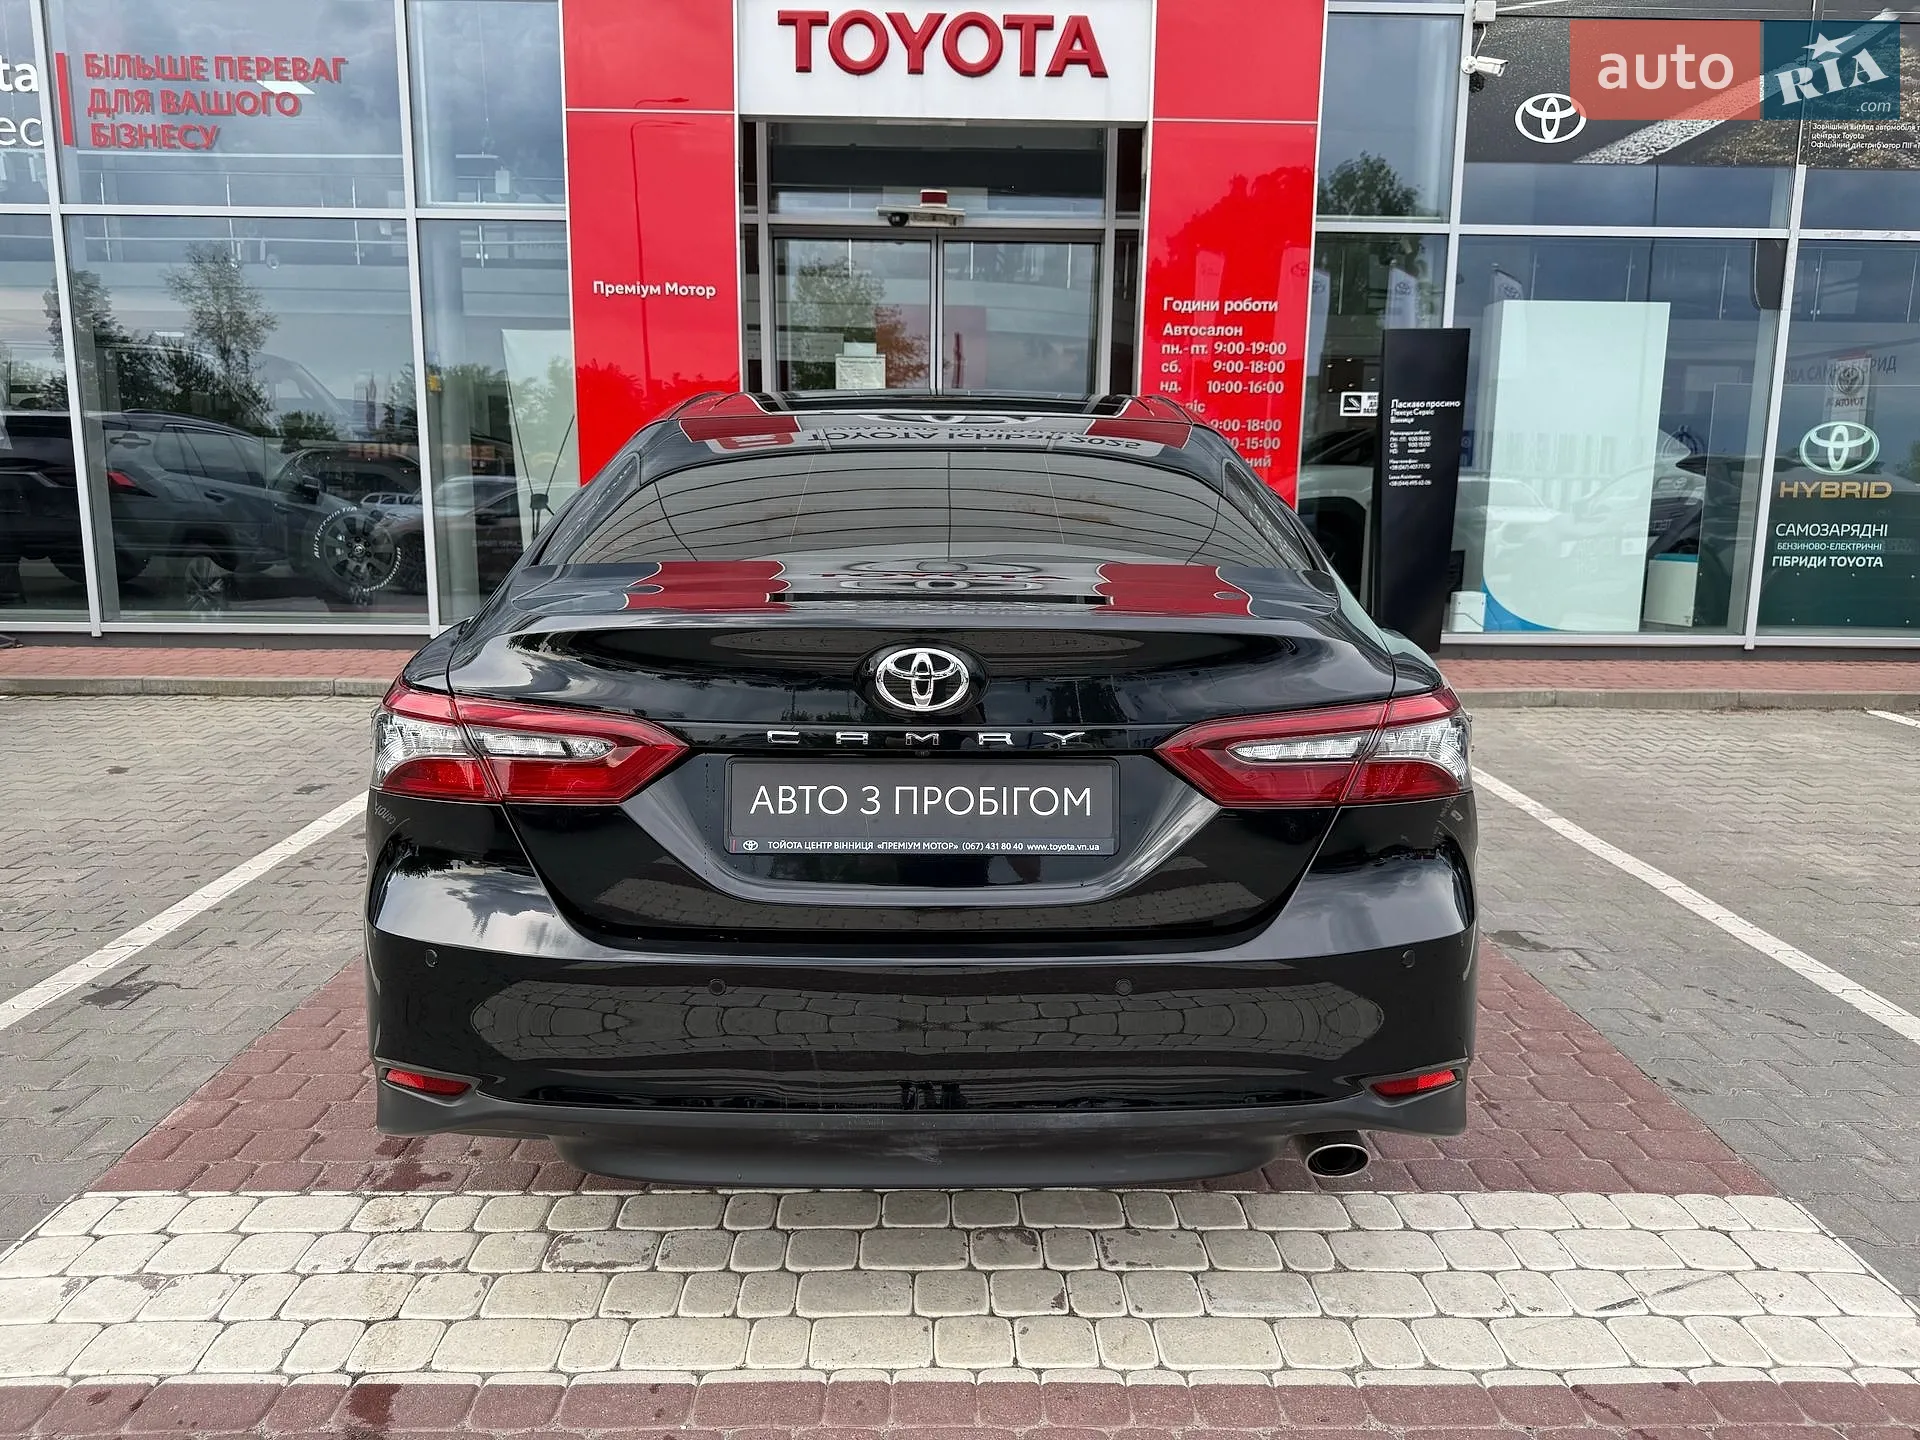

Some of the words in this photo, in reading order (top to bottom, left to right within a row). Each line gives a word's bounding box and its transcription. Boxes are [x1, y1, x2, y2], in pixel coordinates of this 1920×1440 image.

[777, 10, 1109, 78] TOYOTA
[84, 53, 208, 80] БІЛЬШЕ
[214, 55, 349, 83] ПЕРЕВАГ
[87, 87, 152, 117] ДЛЯ
[160, 90, 303, 117] ВАШОГО
[90, 122, 220, 151] БІЗНЕСУ
[1842, 132, 1865, 141] Toyota
[593, 281, 662, 298] Преміум
[665, 282, 716, 298] Мотор
[1163, 297, 1220, 313] Години
[1224, 298, 1279, 315] роботи
[1162, 322, 1243, 337] Автосалон
[1213, 341, 1287, 355] 9:00-19:00
[1161, 361, 1182, 374] сб.
[1213, 360, 1286, 373] 9:00-18:00
[1160, 380, 1182, 393] нд.
[1207, 380, 1284, 394] 10:00-16:00
[1210, 419, 1282, 432] 9:00-18:00
[1780, 481, 1893, 499] HYBRID
[1775, 523, 1889, 539] САМОЗАРЯДНІ
[1777, 542, 1882, 552] БЕНЗИНОВО-ЕЛЕКТРИЧНІ
[1771, 556, 1827, 568] ГІБРИДИ
[1828, 556, 1884, 568] TOYOTA
[766, 729, 1086, 745] CAMRY
[749, 784, 849, 816] АВТО
[894, 785, 1092, 816] ПРОБІГОМ
[767, 841, 804, 852] ТОЙОТА
[804, 841, 833, 852] ЦЕНТР
[834, 841, 874, 852] ВІННИЦЯ
[877, 841, 921, 852] «ПРЕМІУМ
[923, 841, 960, 852] МОТОР»
[962, 841, 985, 852] (067)
[986, 841, 1000, 852] 431
[1000, 841, 1012, 852] 80
[1012, 841, 1024, 852] 40
[1027, 842, 1101, 853] www.toyota.vn.ua
